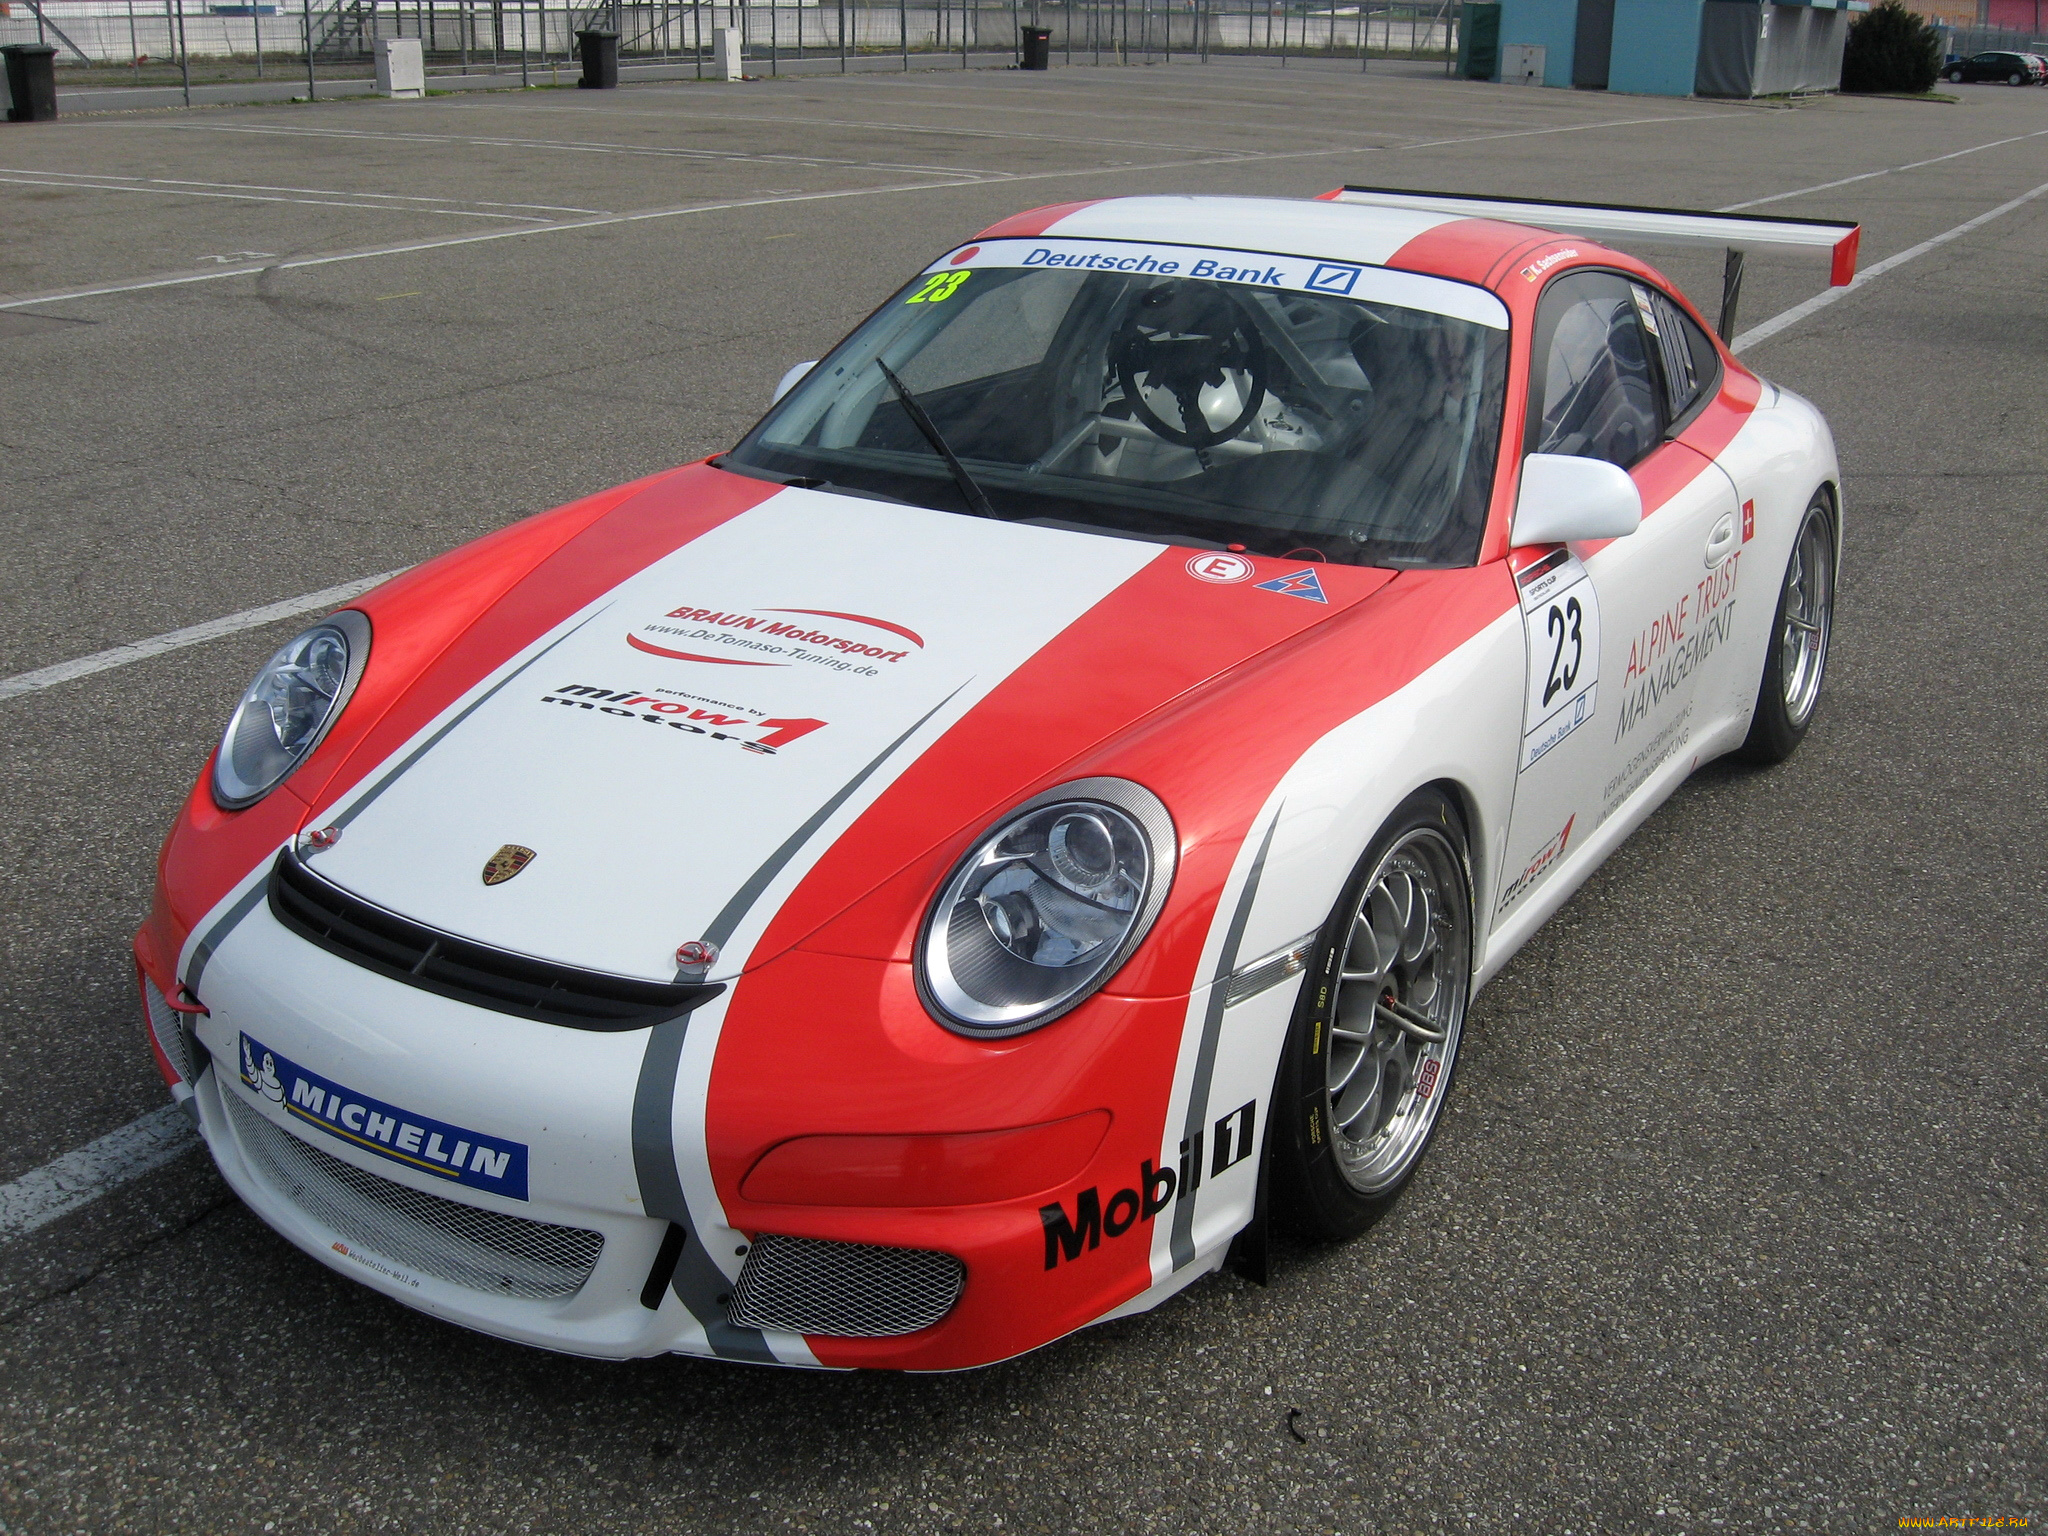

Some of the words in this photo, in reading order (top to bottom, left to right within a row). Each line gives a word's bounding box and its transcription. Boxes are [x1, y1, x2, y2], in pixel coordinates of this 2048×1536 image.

[905, 270, 973, 305] 23
[1022, 248, 1180, 275] Deutsche
[1191, 258, 1286, 288] Bank
[1202, 558, 1236, 578] E
[1529, 581, 1548, 596] SPORTS
[1546, 575, 1557, 585] CUP
[664, 606, 770, 630] BRAUN
[766, 622, 910, 664] Motorsport
[1623, 594, 1689, 688] ALPINE
[1695, 551, 1742, 629] TRUST
[643, 622, 879, 678] www.DeTomaso-Tuning.de
[1543, 596, 1582, 708] 23
[1614, 600, 1737, 745] MANAGEMENT
[540, 696, 778, 755] motors
[655, 687, 746, 713] performance
[747, 707, 767, 717] by
[1530, 734, 1556, 761] Deutsche
[1557, 721, 1571, 739] Bank
[1417, 1060, 1439, 1098] BBS
[291, 1078, 511, 1179] MICHELIN
[1038, 1130, 1204, 1272] Mobil
